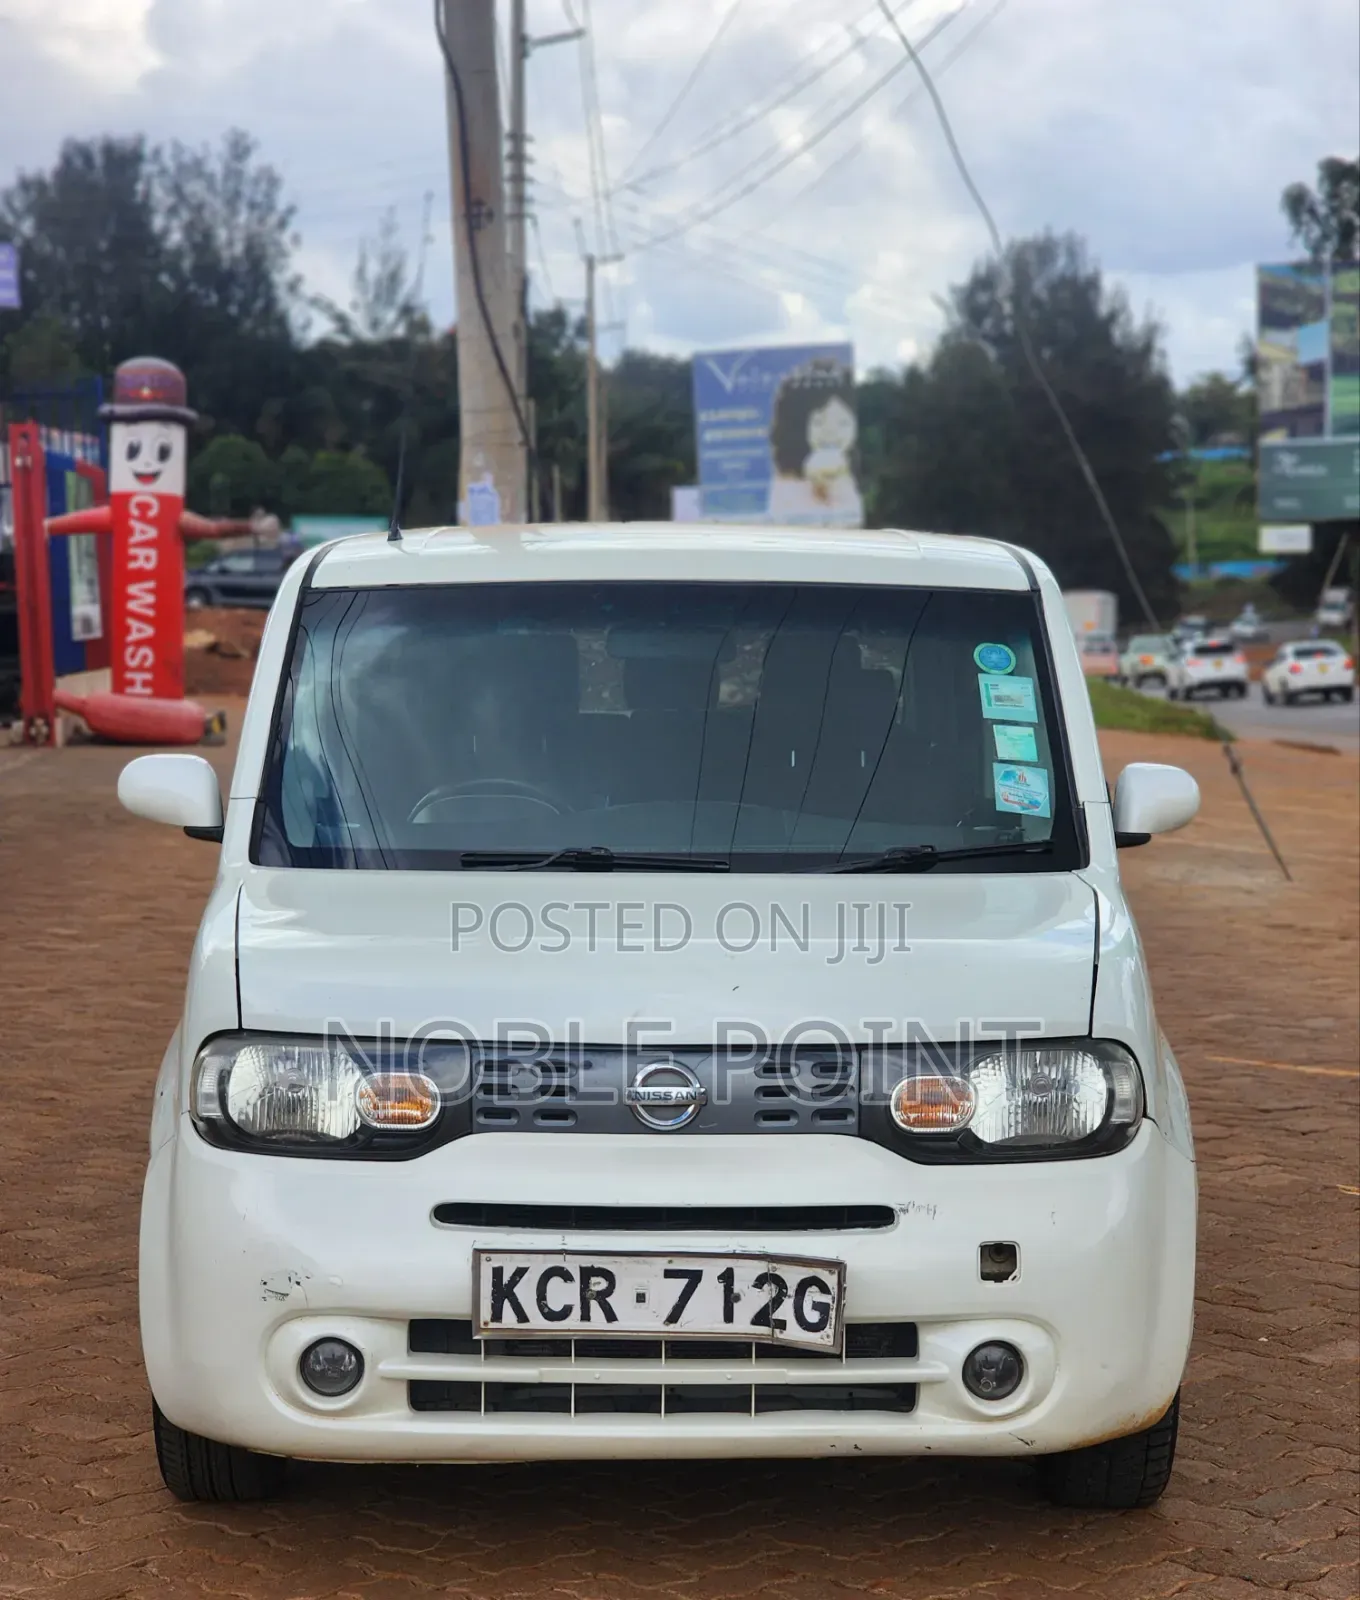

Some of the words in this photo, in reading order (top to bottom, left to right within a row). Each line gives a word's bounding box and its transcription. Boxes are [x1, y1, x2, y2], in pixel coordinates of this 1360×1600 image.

[127, 494, 159, 570] CAR
[124, 582, 157, 696] WASH
[633, 1091, 697, 1101] NISSAN
[490, 1264, 619, 1324] KCR
[662, 1266, 833, 1333] 712G
